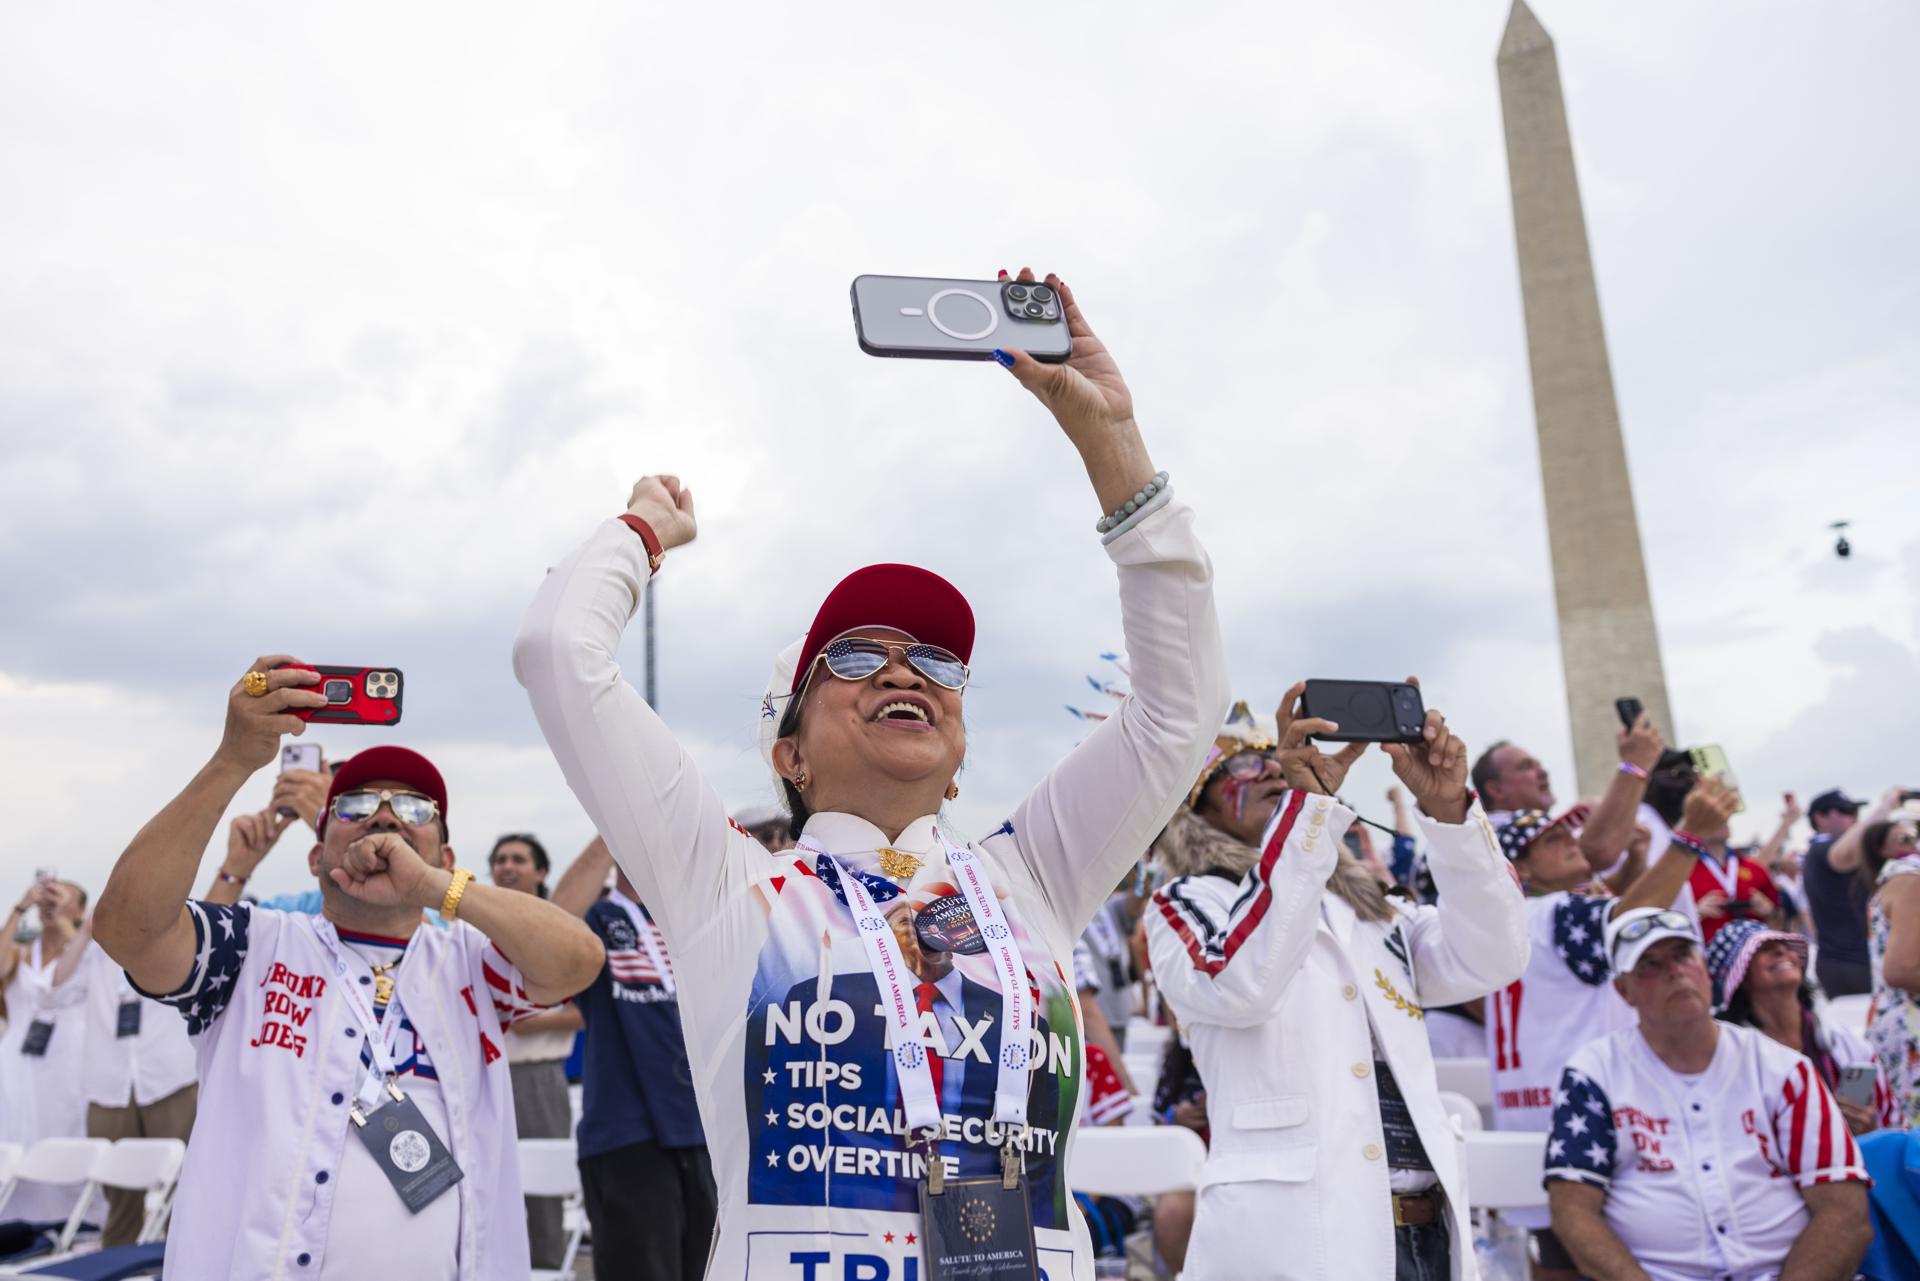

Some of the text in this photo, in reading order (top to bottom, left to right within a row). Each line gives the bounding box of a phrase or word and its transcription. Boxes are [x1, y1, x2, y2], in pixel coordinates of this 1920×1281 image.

[931, 896, 967, 914] SALUTE
[935, 904, 971, 922] AMERIC
[876, 937, 908, 1029] SALUTE TO AMERICA
[1000, 945, 1021, 1031] SALUTE TO AMERICA
[765, 999, 856, 1046] NO
[785, 1061, 862, 1091] TIPS
[787, 1102, 912, 1136] SOCIAL
[939, 1250, 1024, 1266] SALUTE TO AMERICA
